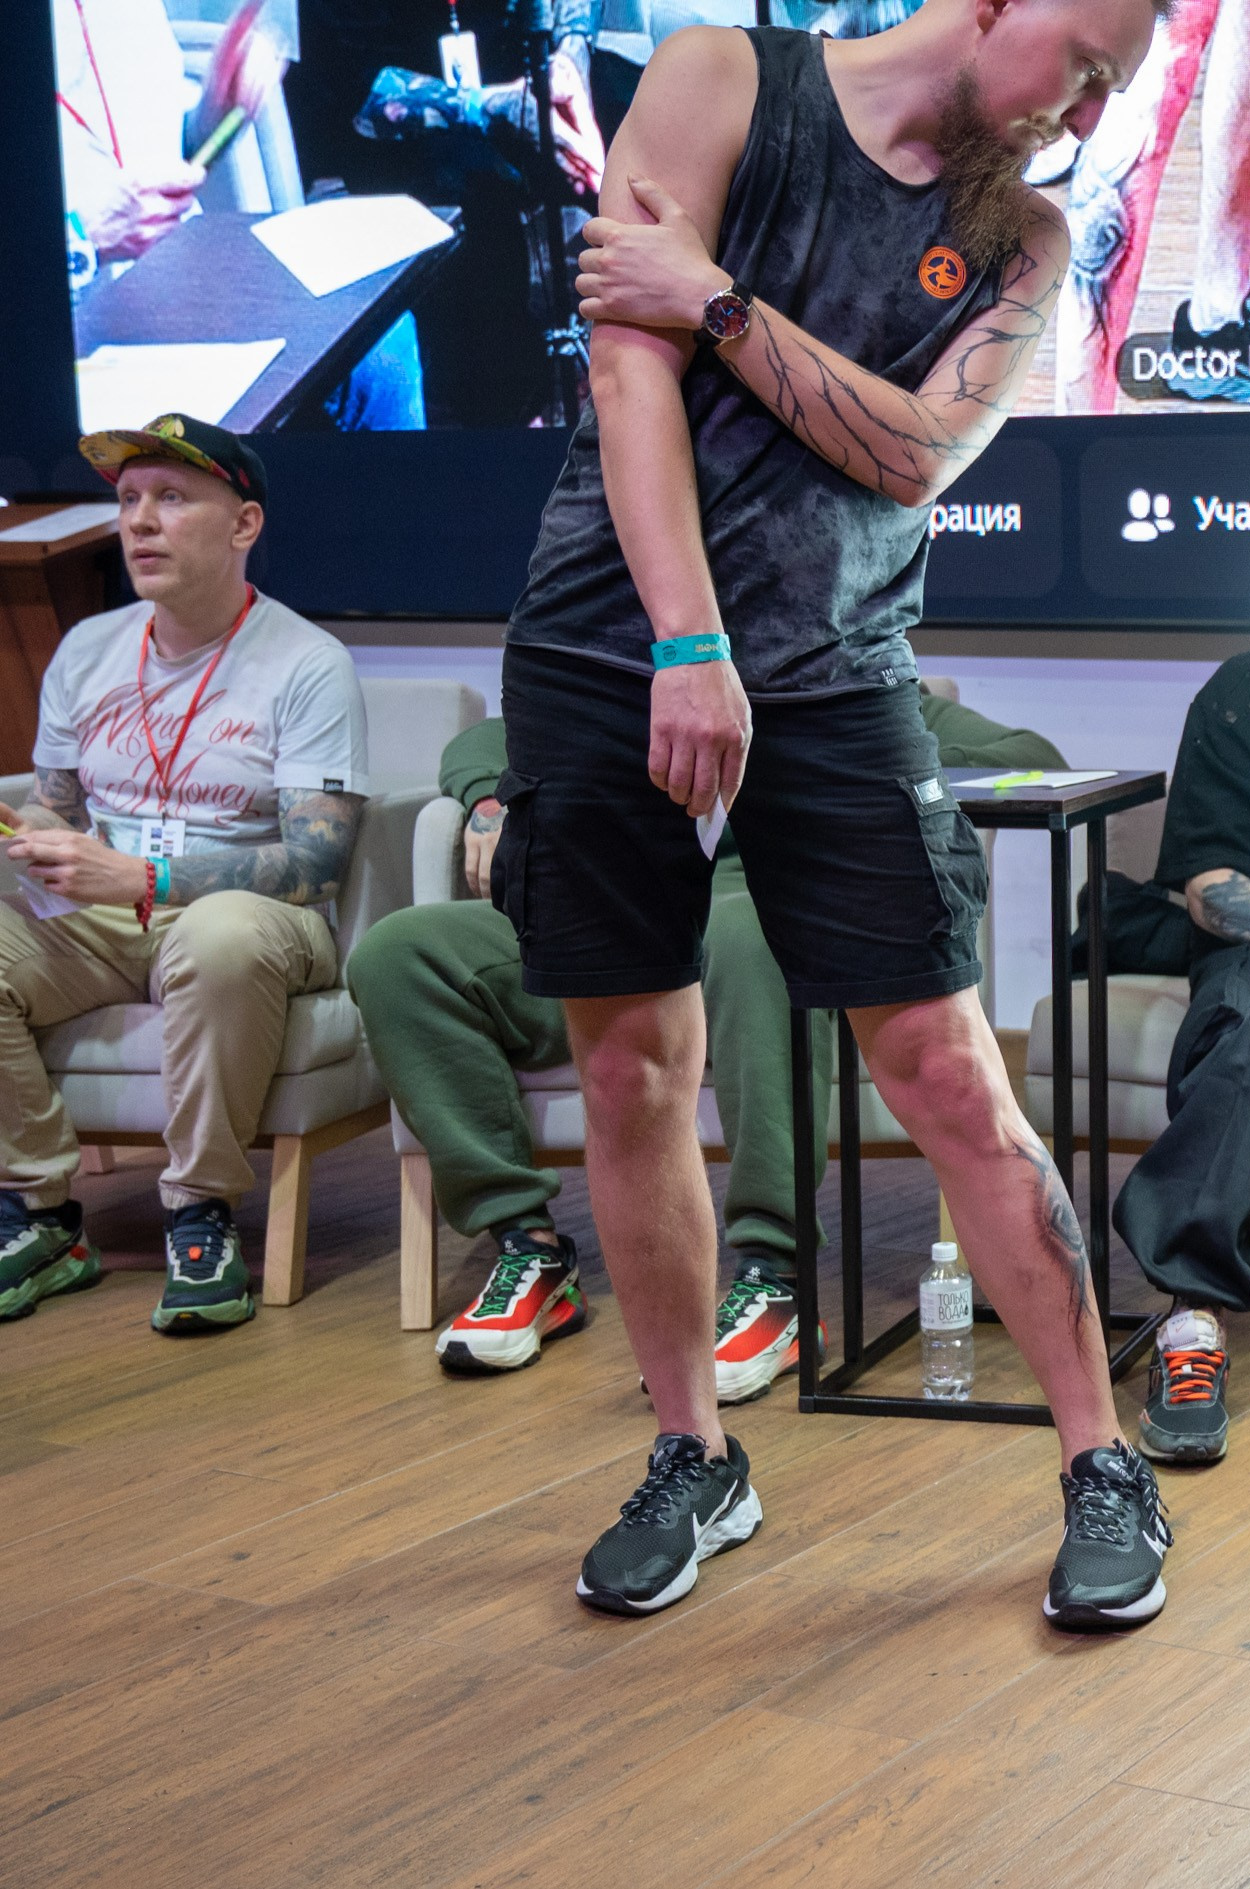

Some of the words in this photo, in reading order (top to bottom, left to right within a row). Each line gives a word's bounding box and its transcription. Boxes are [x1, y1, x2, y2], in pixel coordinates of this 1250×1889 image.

[1133, 346, 1242, 381] Doctor
[208, 717, 257, 745] on
[937, 1290, 969, 1306] ТОЛЬКО
[938, 1304, 965, 1321] ВОДА
